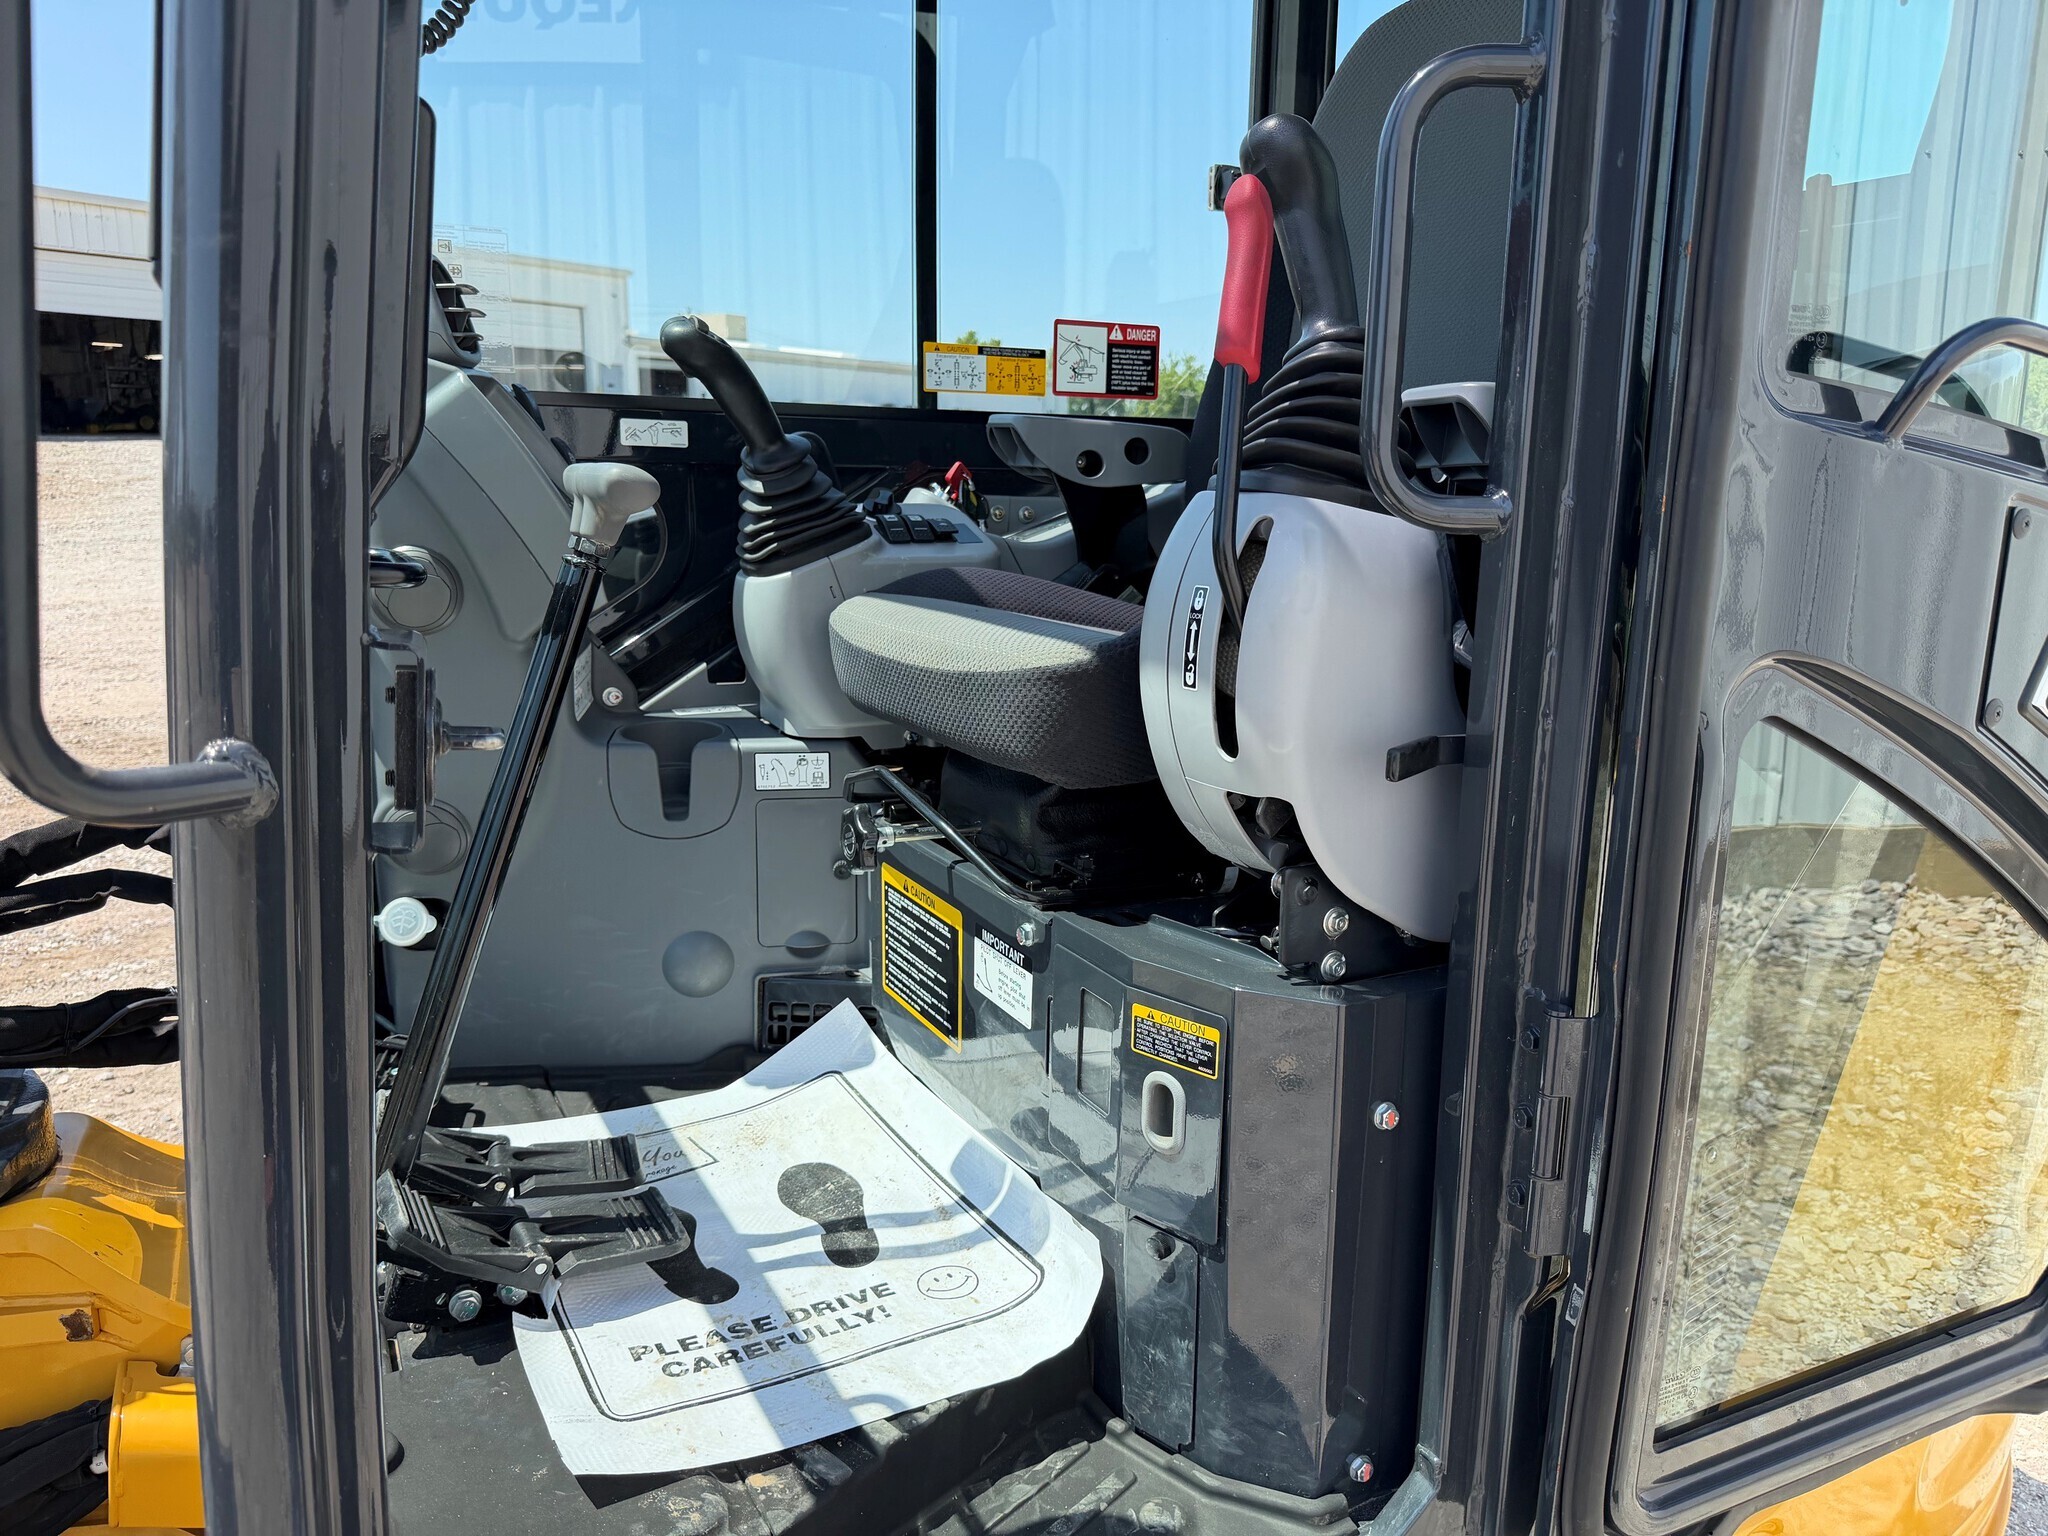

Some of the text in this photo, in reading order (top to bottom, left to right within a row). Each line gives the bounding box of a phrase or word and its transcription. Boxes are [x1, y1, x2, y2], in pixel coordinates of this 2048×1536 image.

[1126, 328, 1156, 342] DANGER
[946, 345, 970, 353] CAUTION
[910, 886, 936, 910] CAUTION
[981, 928, 1025, 966] IMPORTANT
[1013, 965, 1026, 980] LEVER
[1160, 1013, 1205, 1036] CAUTION
[1167, 1032, 1187, 1043] SELECTOR
[1198, 1037, 1214, 1046] BEFORE
[1179, 1042, 1191, 1050] LEVER
[1193, 1046, 1212, 1057] CONTROL
[1194, 1052, 1207, 1061] LEVER
[628, 1282, 896, 1362] PLEASE DRIVE
[661, 1305, 892, 1377] CAREFULLY!
